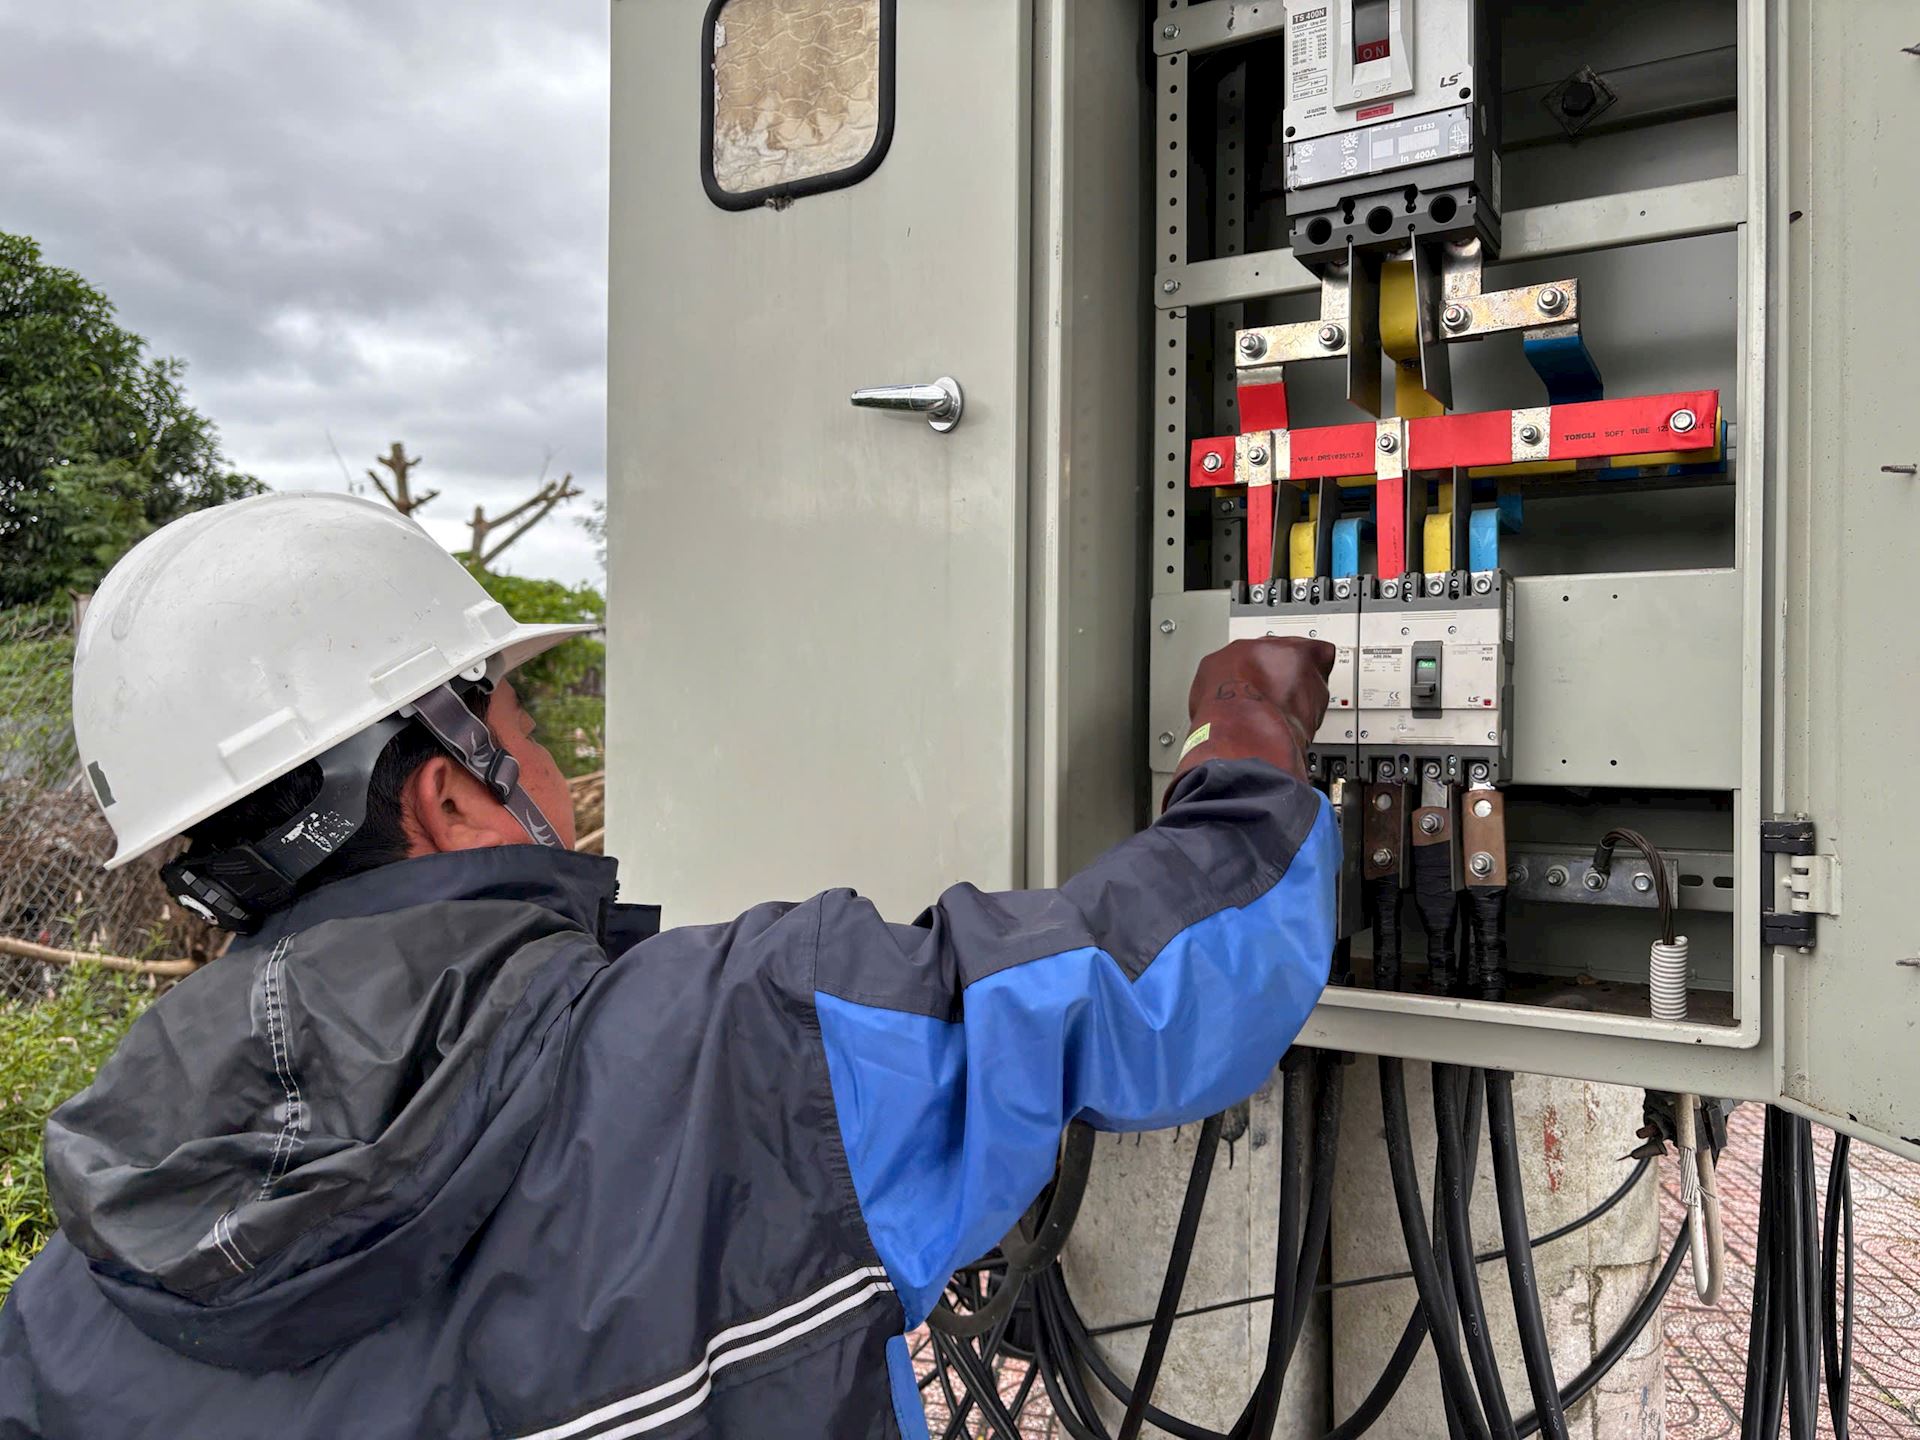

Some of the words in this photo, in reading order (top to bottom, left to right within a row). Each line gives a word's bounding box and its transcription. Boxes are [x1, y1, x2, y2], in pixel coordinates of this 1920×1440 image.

[1295, 14, 1305, 23] TS
[1363, 45, 1384, 59] ON
[1440, 73, 1461, 88] LS
[1375, 82, 1392, 94] OFF
[1400, 154, 1409, 163] In
[1414, 149, 1437, 160] 400A
[1564, 432, 1596, 441] TONGLI
[1604, 430, 1624, 438] SOFT
[1631, 427, 1650, 436] TUBE
